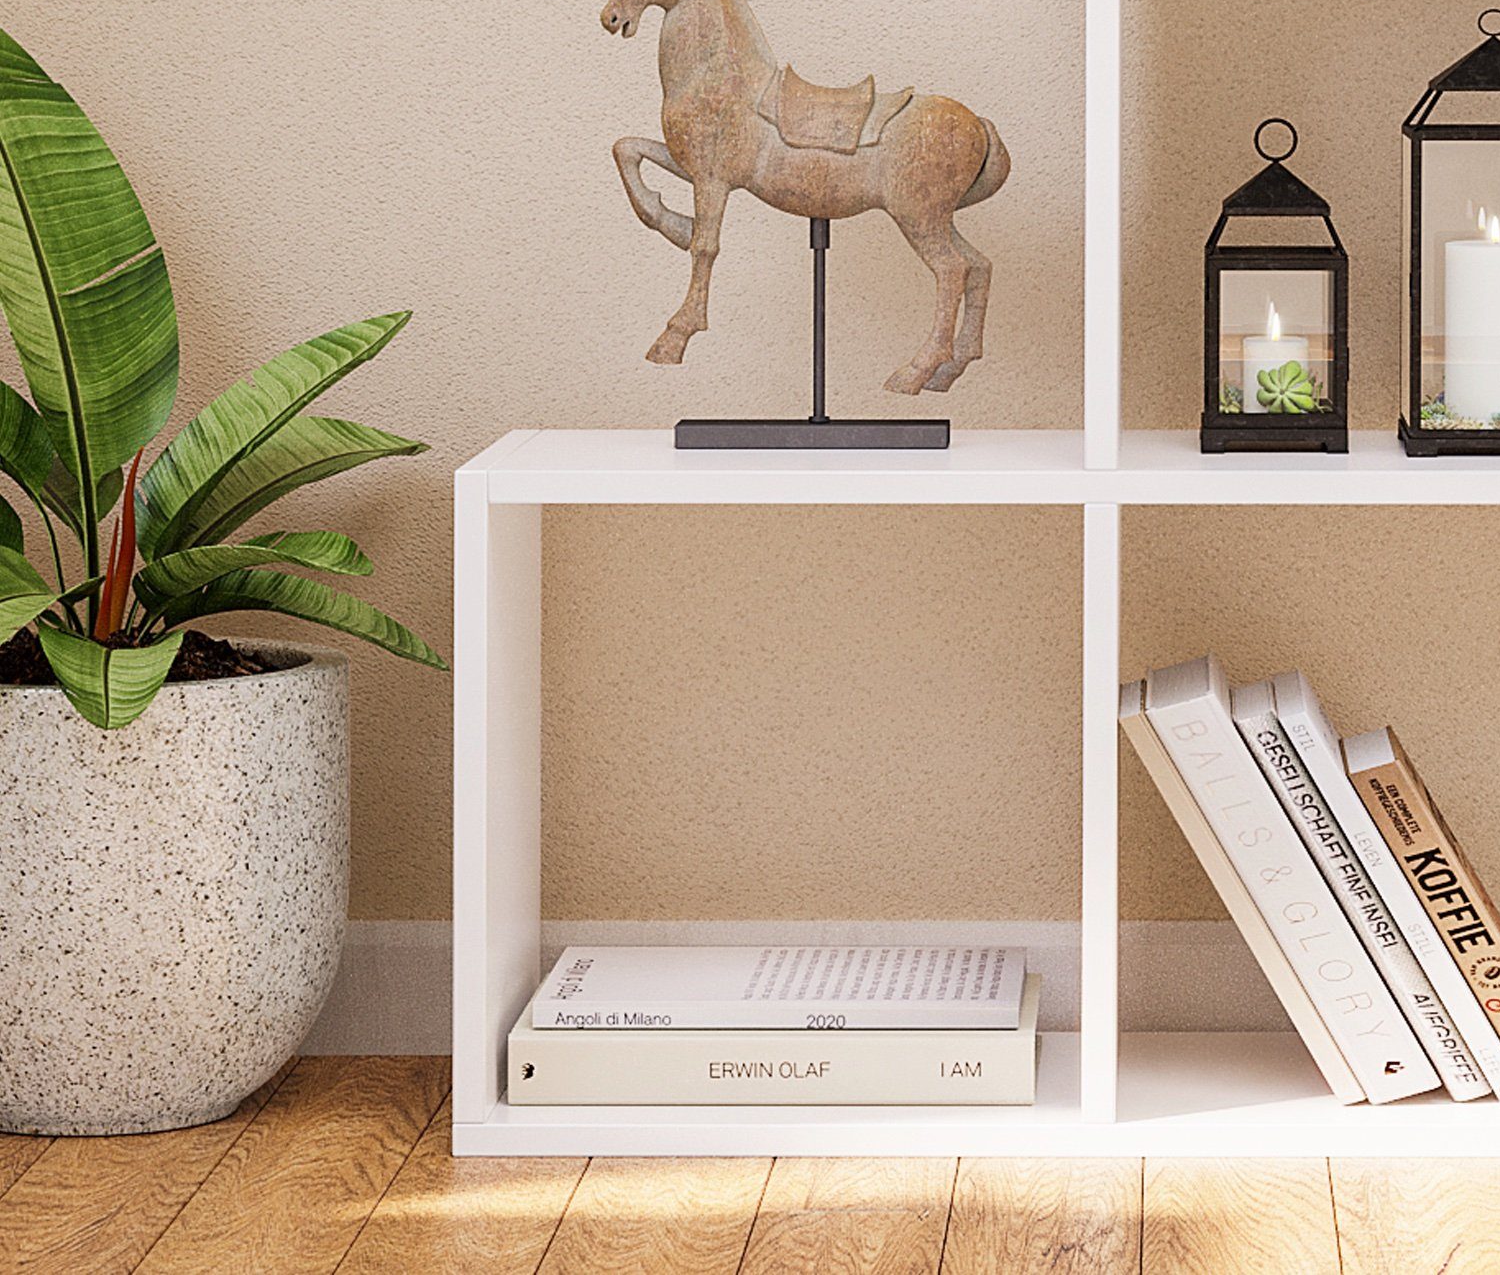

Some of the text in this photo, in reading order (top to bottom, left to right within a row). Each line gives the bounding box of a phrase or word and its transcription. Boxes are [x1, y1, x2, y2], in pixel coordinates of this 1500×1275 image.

[1394, 798, 1422, 834] COMPLETE
[1353, 830, 1384, 869] LEVEN
[1172, 719, 1392, 1039] BALLS & GLORY
[1404, 846, 1496, 955] KOFFIE
[554, 1011, 846, 1030] Angoli di Milano 2020
[708, 1061, 775, 1079] ERWIN
[778, 1061, 832, 1079] OLAF
[949, 1061, 983, 1078] AM
